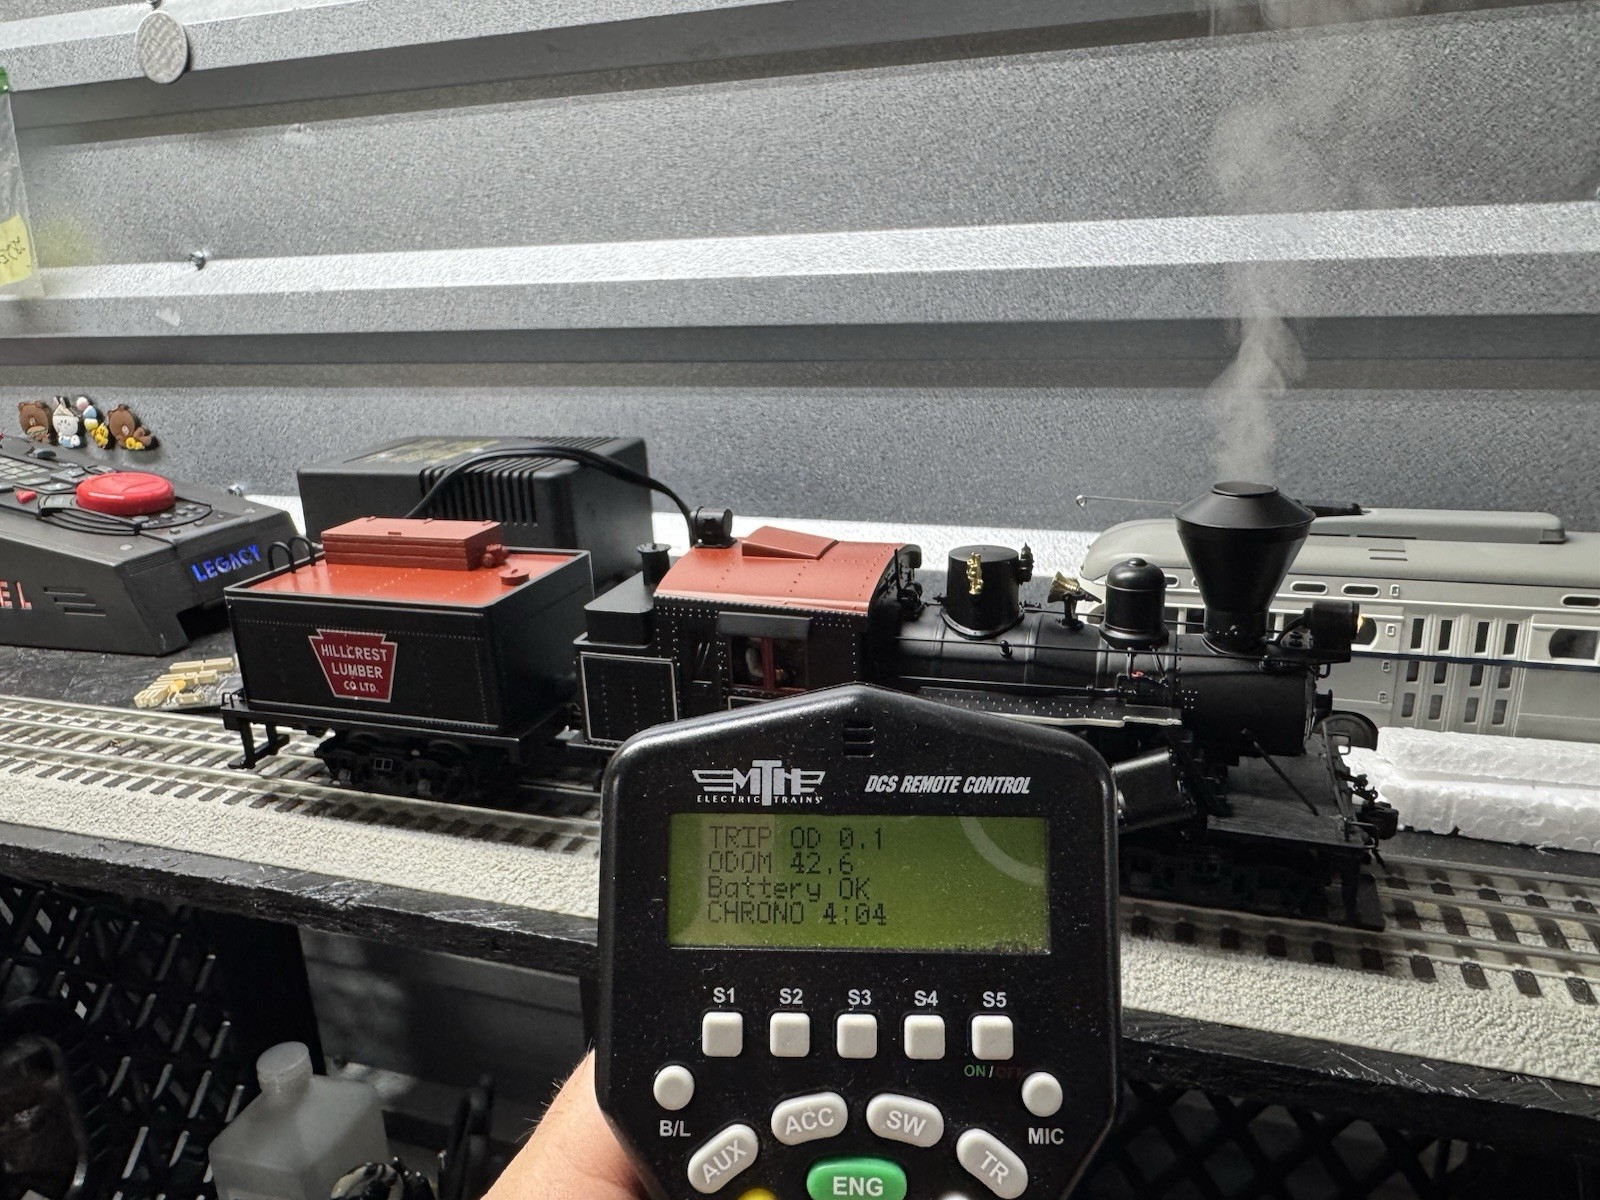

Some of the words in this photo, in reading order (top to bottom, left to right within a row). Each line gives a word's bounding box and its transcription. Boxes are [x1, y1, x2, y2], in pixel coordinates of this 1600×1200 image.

[191, 544, 261, 582] LEGACY
[321, 644, 387, 662] HILLCREST
[331, 662, 384, 679] LUMBER
[864, 775, 898, 793] DCS
[900, 775, 962, 794] REMOTE
[963, 776, 1031, 794] CONTROL
[697, 794, 760, 803] ELECTRIC
[774, 795, 821, 804] TRAINS
[709, 826, 772, 849] TRIP
[790, 826, 821, 849] OD
[708, 850, 772, 874] ODOM
[708, 875, 821, 902] Battery
[839, 877, 870, 900] OK
[707, 900, 804, 925] CHRONO
[822, 902, 887, 926] 4:04
[712, 987, 735, 1003] S1
[779, 988, 803, 1005] S2
[847, 989, 872, 1006] S3
[914, 990, 939, 1007] S4
[982, 991, 1007, 1008] S5
[963, 1064, 986, 1077] ON
[659, 1119, 692, 1137] B/L
[785, 1107, 835, 1136] ACC
[886, 1110, 926, 1137] SW
[1028, 1127, 1064, 1145] MIC
[702, 1139, 748, 1184] AUX
[979, 1150, 1010, 1186] TR
[832, 1176, 884, 1197] ENG
